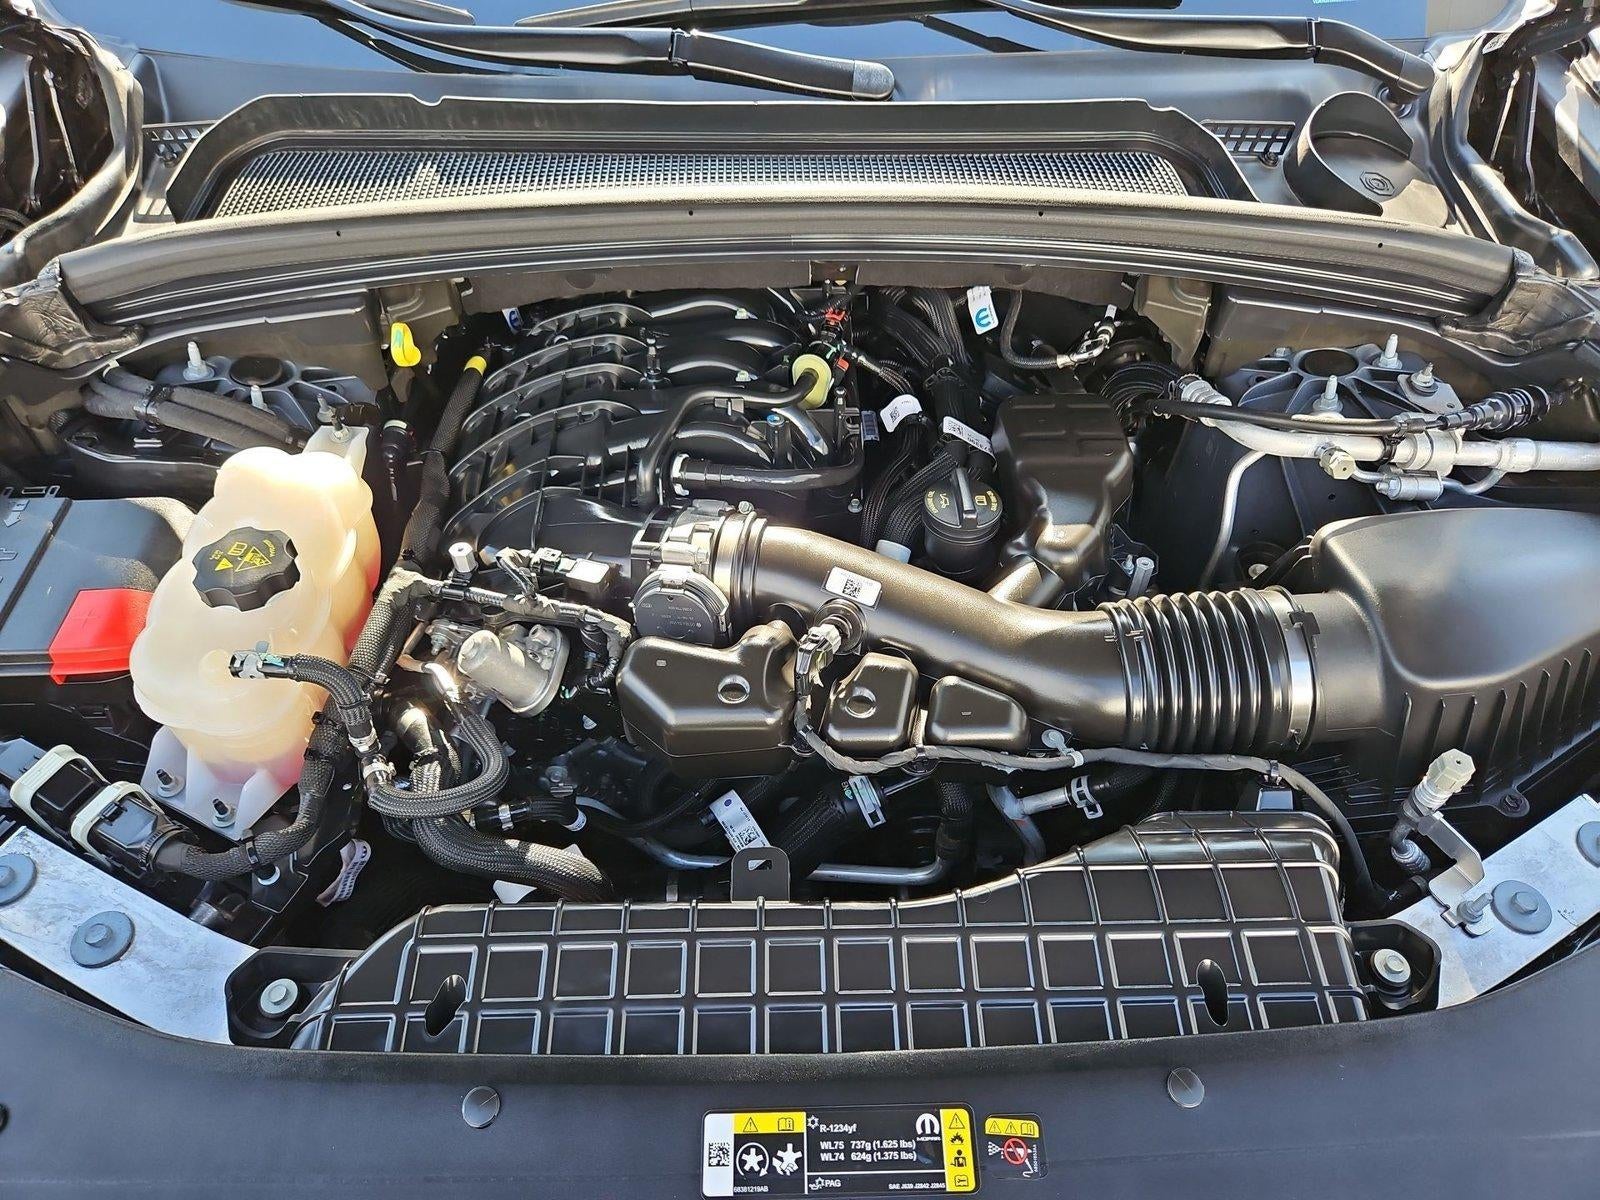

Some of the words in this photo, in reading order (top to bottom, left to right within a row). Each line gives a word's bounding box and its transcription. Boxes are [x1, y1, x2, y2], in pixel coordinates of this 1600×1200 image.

[819, 1123, 857, 1134] R-1234yf
[820, 1141, 845, 1150] WL75
[850, 1140, 872, 1151] 737g
[872, 1139, 898, 1150] (1.625
[899, 1139, 916, 1150] lbs)
[820, 1152, 845, 1162] WL74
[850, 1152, 872, 1163] 624g
[873, 1151, 899, 1162] (1.375
[900, 1150, 917, 1162] lbs)
[825, 1179, 841, 1188] PAG
